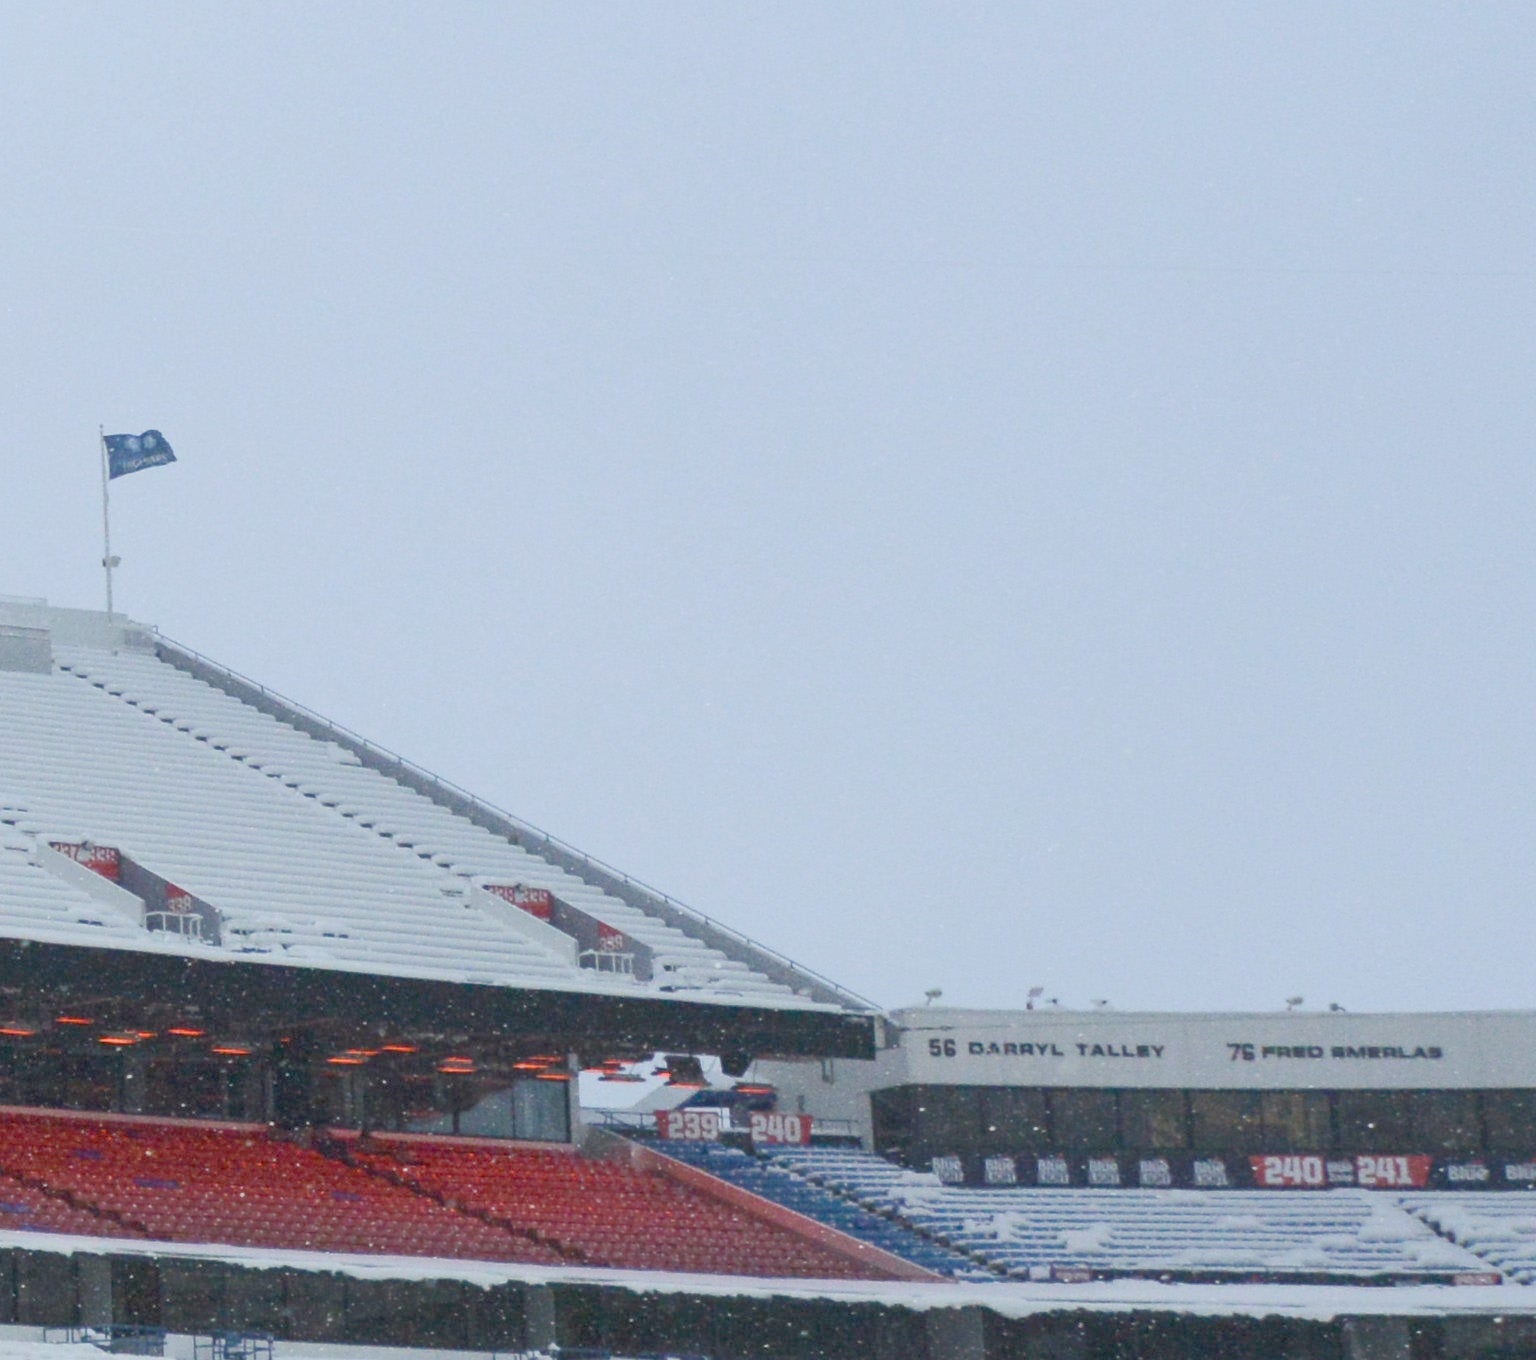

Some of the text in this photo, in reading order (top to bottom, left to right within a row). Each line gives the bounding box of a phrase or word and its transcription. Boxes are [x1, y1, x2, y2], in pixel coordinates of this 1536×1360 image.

[929, 1038, 1165, 1058] 56 DARRYL TALLEY
[1261, 1045, 1324, 1059] FRED
[668, 1114, 718, 1140] 239
[750, 1115, 801, 1142] 240
[1264, 1156, 1323, 1185] 240
[1357, 1156, 1413, 1185] 241
